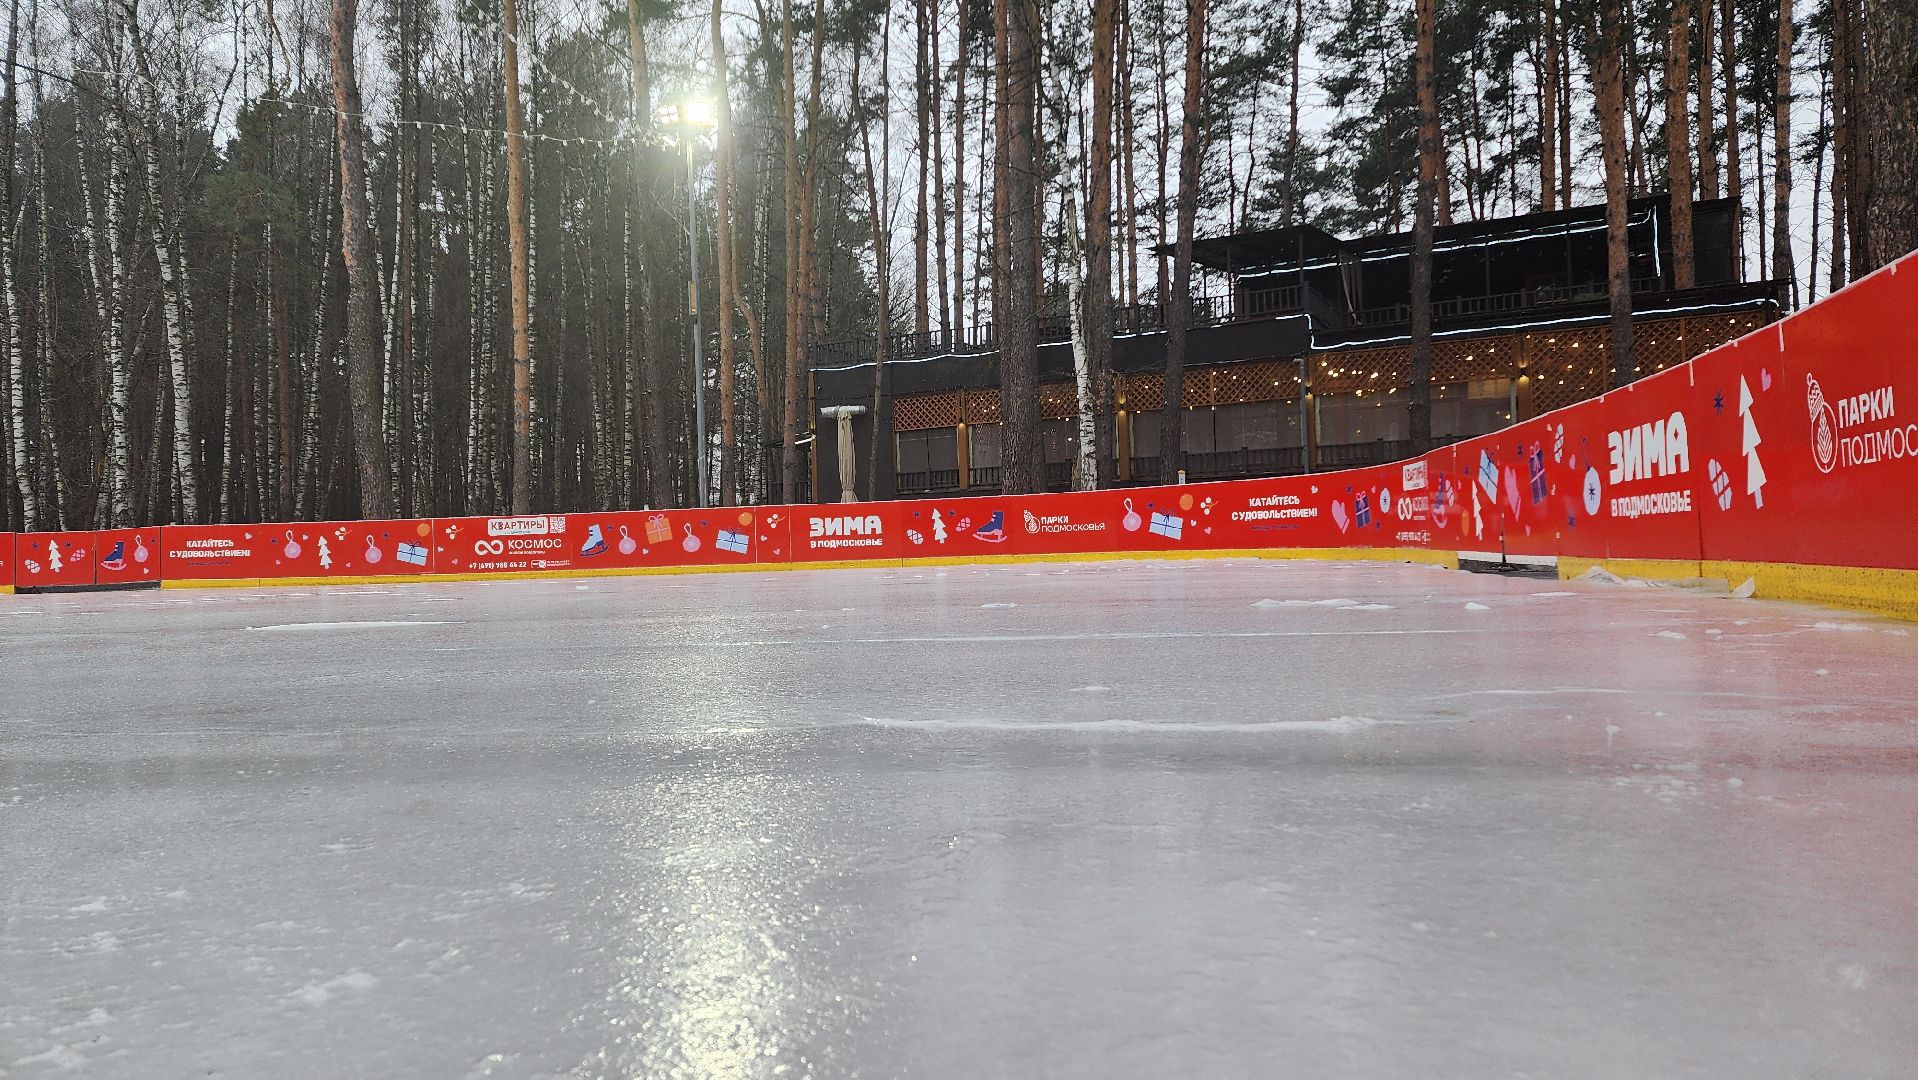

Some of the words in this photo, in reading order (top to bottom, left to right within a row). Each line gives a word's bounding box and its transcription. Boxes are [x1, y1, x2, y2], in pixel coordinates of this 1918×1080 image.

[1838, 386, 1894, 428] ПАРКИ
[1608, 411, 1690, 485] ЗИМА
[1841, 424, 1918, 467] ПОДМОС
[1249, 495, 1300, 507] КАТАЙТЕСЬ
[1611, 499, 1618, 517] В
[1618, 490, 1692, 519] ПОДМОСКОВЬЕ
[1041, 515, 1069, 524] ПАРКИ
[1231, 511, 1238, 521] С
[1239, 508, 1318, 521] УДОВОЛЬСТВИЕМ!
[491, 519, 545, 530] КВАРТИРЫ
[809, 515, 882, 537] ЗИМА
[1041, 522, 1106, 533] ПОДМОСКОВЬЯ
[186, 538, 234, 548] КАТАЙТЕСЬ
[508, 538, 562, 549] КОСМОС
[810, 540, 817, 549] В
[817, 538, 883, 548] ПОДМОСКОВЬЕ
